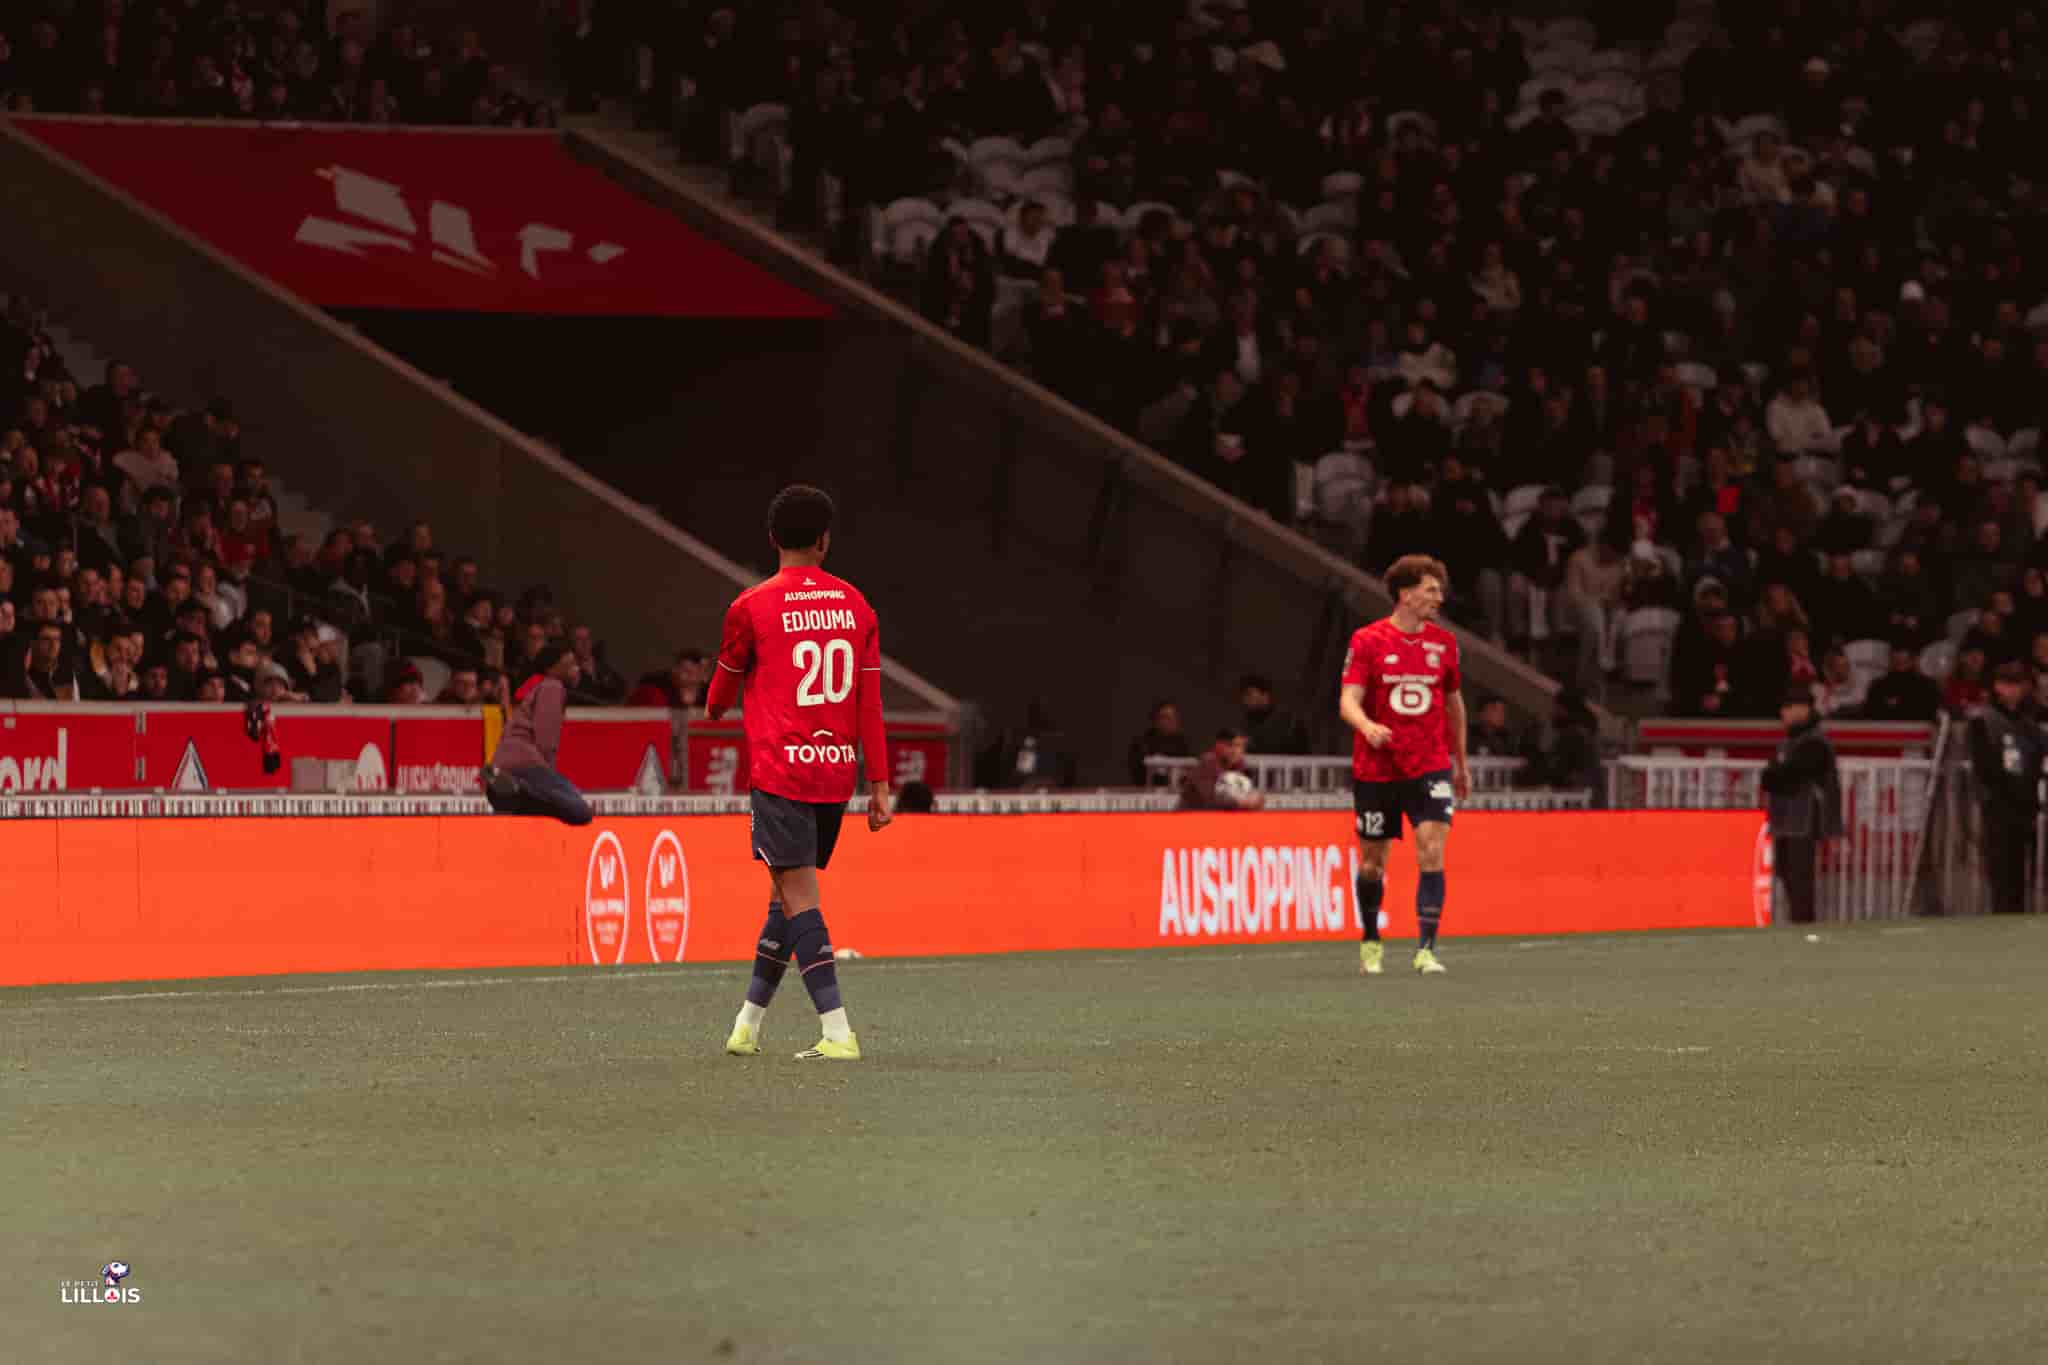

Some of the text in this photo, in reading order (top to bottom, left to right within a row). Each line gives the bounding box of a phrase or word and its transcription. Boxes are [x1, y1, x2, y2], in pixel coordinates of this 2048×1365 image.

[781, 609, 856, 632] EDJOUMA
[792, 639, 854, 706] 20
[784, 744, 856, 764] TOYOTA
[1364, 811, 1384, 835] 12
[1159, 845, 1345, 937] AUSHOPPING
